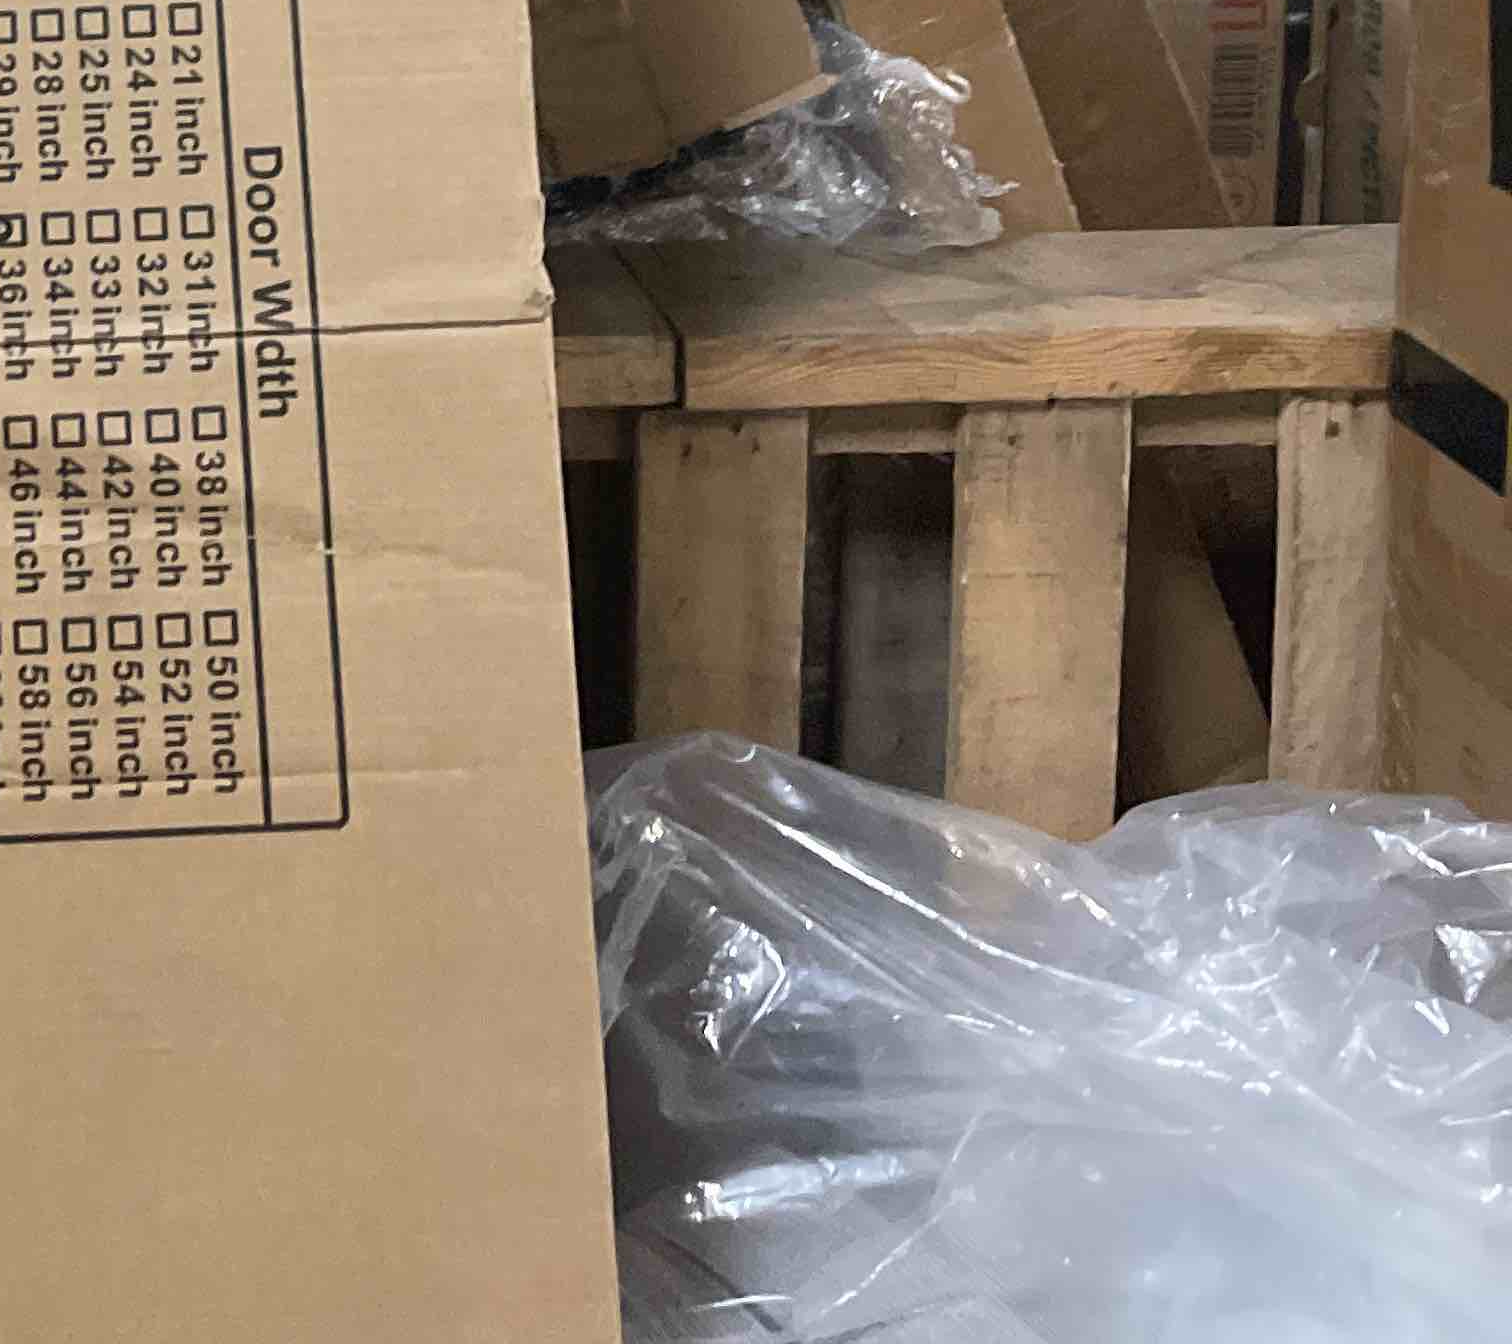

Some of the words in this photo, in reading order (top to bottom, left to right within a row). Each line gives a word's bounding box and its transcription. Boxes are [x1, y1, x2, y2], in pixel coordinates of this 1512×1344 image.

[32, 51, 64, 94] 28
[80, 49, 110, 93] 25
[126, 48, 157, 92] 24
[172, 45, 203, 84] 21
[36, 104, 69, 181] inch
[83, 102, 115, 179] inch
[129, 100, 162, 178] inch
[175, 97, 208, 175] inch
[244, 146, 283, 268] Door
[43, 257, 75, 302] 34
[90, 256, 122, 299] 33
[136, 253, 169, 297] 32
[184, 251, 216, 291] 31
[1, 310, 34, 381] inch
[51, 307, 81, 379] inch
[93, 306, 124, 378] inch
[141, 305, 173, 375] inch
[187, 302, 220, 373] inch
[251, 279, 299, 420] Wdth
[8, 458, 41, 501] 46
[55, 456, 88, 501] 44
[102, 455, 134, 500] 42
[149, 454, 181, 497] 40
[196, 451, 227, 496] 38
[14, 511, 46, 594] inch
[61, 508, 93, 592] inch
[107, 507, 140, 589] inch
[154, 505, 187, 587] inch
[198, 505, 232, 586] inch
[18, 664, 50, 710] 58
[65, 663, 98, 708] 56
[113, 660, 145, 707] 54
[160, 659, 192, 704] 52
[207, 656, 239, 701] 50
[21, 720, 54, 801] inch
[68, 719, 102, 799] inch
[115, 717, 149, 797] inch
[164, 715, 198, 795] inch
[211, 711, 245, 793] inch
